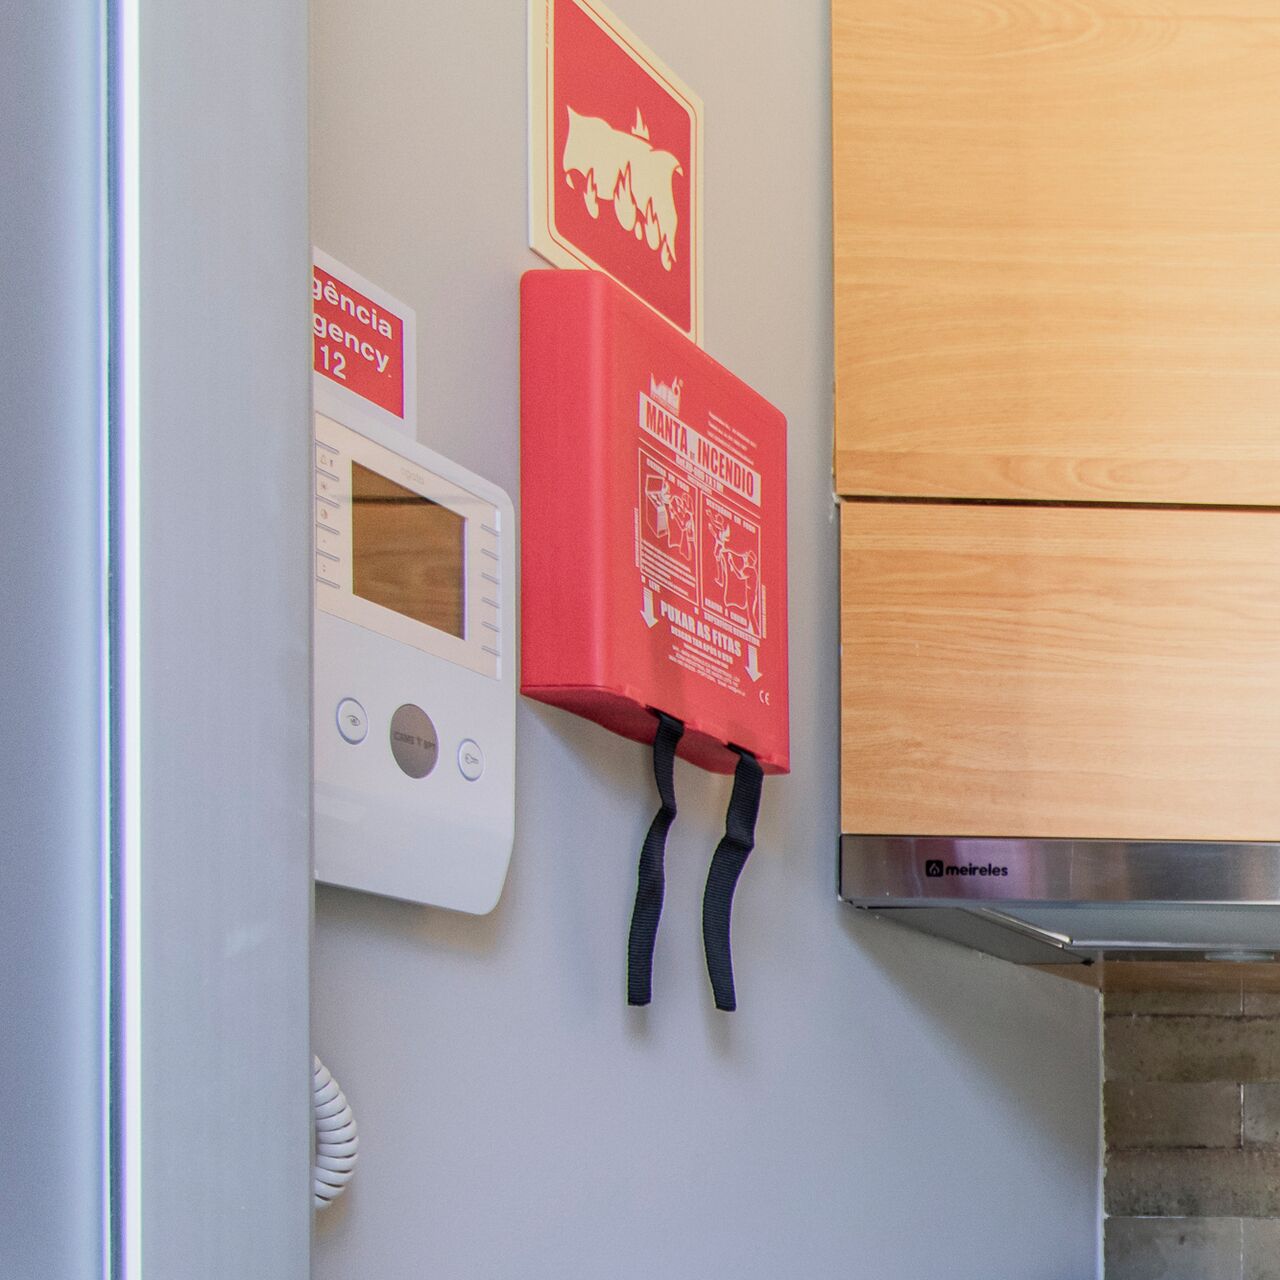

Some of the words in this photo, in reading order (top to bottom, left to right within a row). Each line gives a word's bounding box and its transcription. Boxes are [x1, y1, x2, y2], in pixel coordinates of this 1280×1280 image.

[320, 344, 347, 380] 12
[645, 400, 688, 456] MANTA
[697, 437, 754, 498] INCENDIO
[660, 599, 696, 634] PUXAR
[696, 620, 711, 642] AS
[711, 628, 742, 657] FITAS
[945, 863, 1009, 877] meireles
